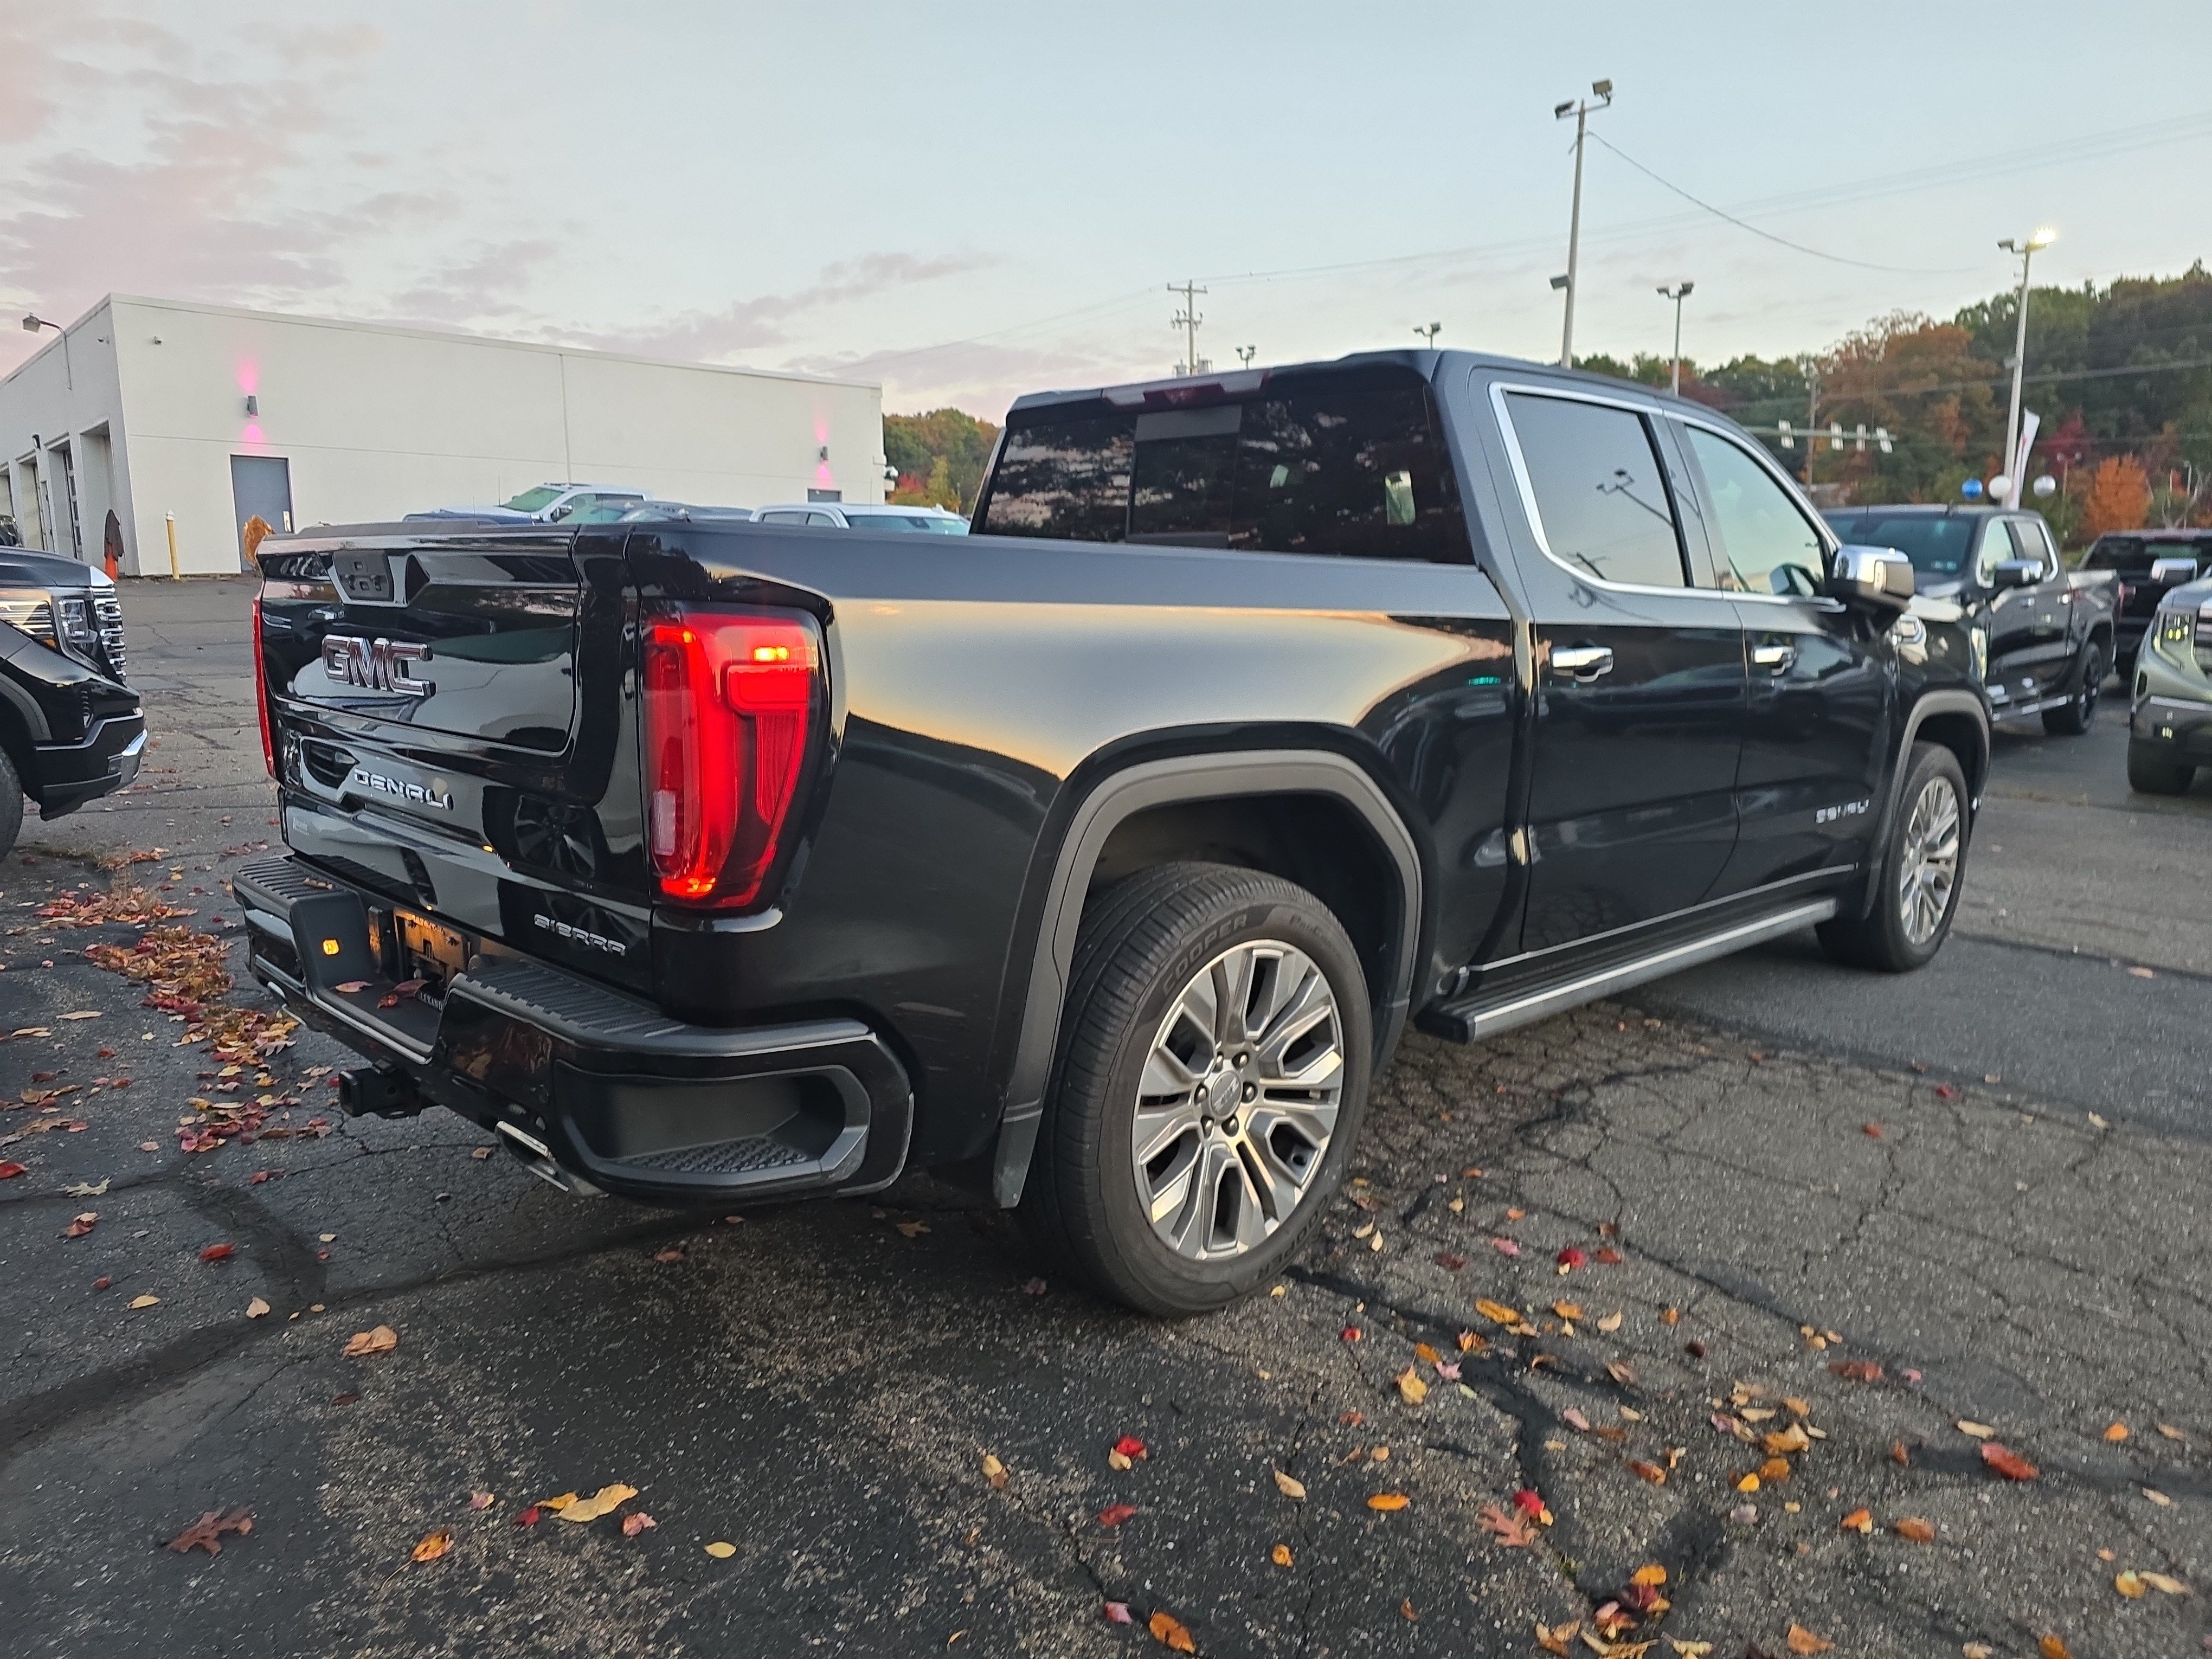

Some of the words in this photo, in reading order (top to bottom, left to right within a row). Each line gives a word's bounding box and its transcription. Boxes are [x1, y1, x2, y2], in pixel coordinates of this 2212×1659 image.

[321, 634, 436, 697] GMC
[354, 768, 454, 811] DENALI
[533, 914, 627, 957] SIERRA
[1163, 914, 1248, 995] COOPER
